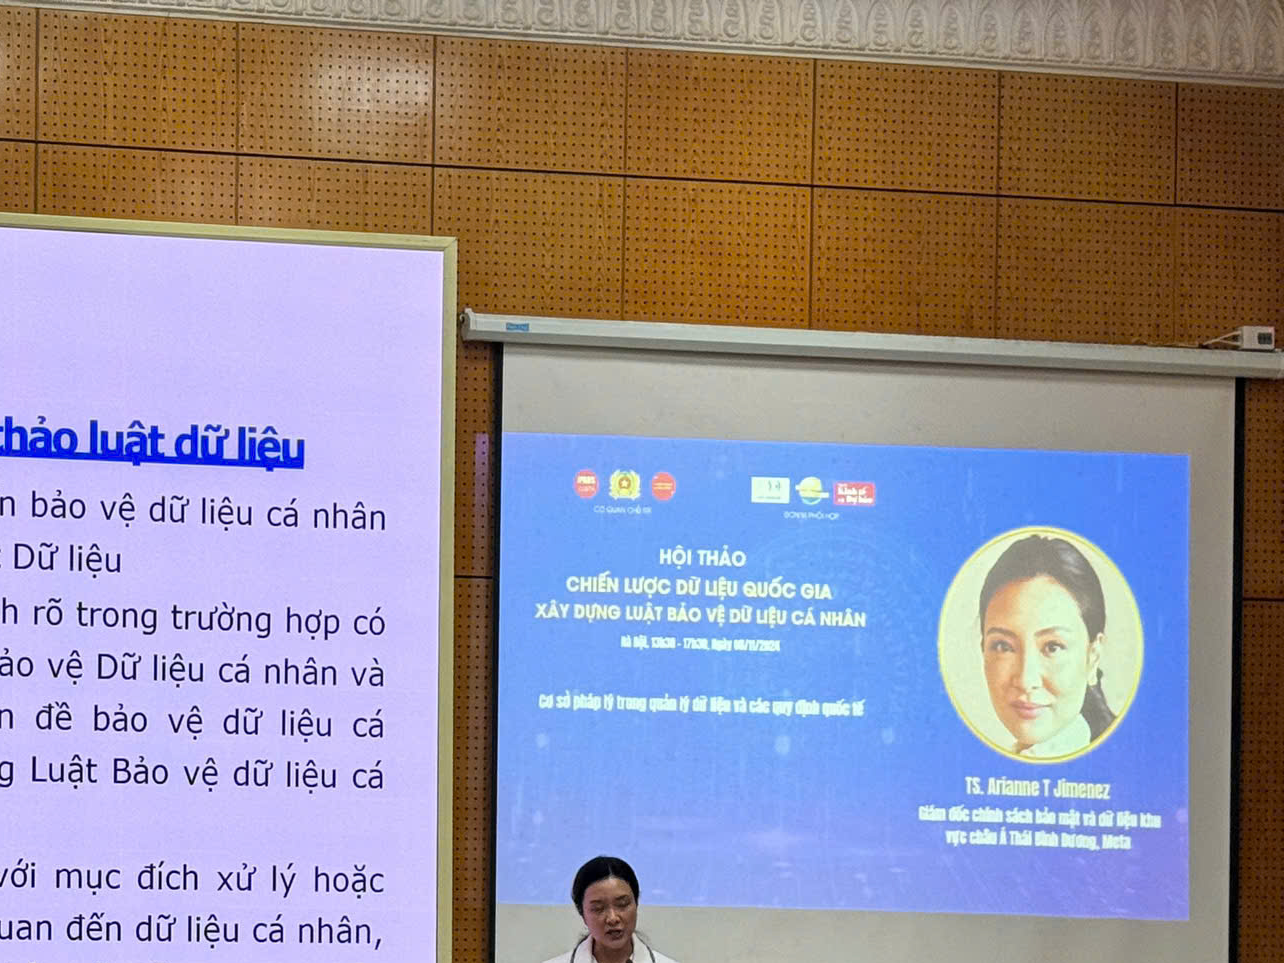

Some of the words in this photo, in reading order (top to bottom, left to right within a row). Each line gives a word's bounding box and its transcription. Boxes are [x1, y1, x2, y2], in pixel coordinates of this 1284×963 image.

[89, 419, 165, 466] luật
[174, 423, 230, 464] dữ
[238, 425, 305, 472] liệu
[31, 489, 86, 520] bảo
[99, 492, 136, 528] vệ
[149, 495, 190, 524] dữ
[201, 496, 253, 532] liệu
[266, 497, 299, 528] cá
[313, 501, 386, 531] nhân
[13, 542, 60, 571] Dữ
[69, 543, 121, 579] liệu
[659, 545, 692, 570] HỘI
[697, 545, 747, 567] THẢO
[566, 571, 619, 593] CHIẾN
[624, 576, 671, 599] LƯỢC
[675, 576, 701, 595] DỮ
[705, 576, 738, 600] LIỆU
[743, 576, 796, 598] QUỐC
[801, 583, 832, 600] GIA
[535, 600, 569, 619] XÂY
[573, 603, 621, 623] DỰNG
[625, 602, 663, 625] LUẬT
[667, 602, 702, 622] BẢO
[706, 604, 725, 628] VỆ
[729, 605, 752, 624] DỮ
[756, 606, 787, 629] LIỆU
[791, 607, 816, 626] CÁ
[820, 608, 866, 627] NHÂN
[965, 776, 984, 796] TS.
[987, 776, 1040, 797] Arianne
[1042, 778, 1051, 797] T
[1053, 777, 1111, 800] Jimenez
[55, 868, 121, 896] mục
[137, 860, 199, 891] đích
[217, 862, 257, 892] xử
[272, 862, 297, 899] lý
[314, 864, 385, 900] hoặc
